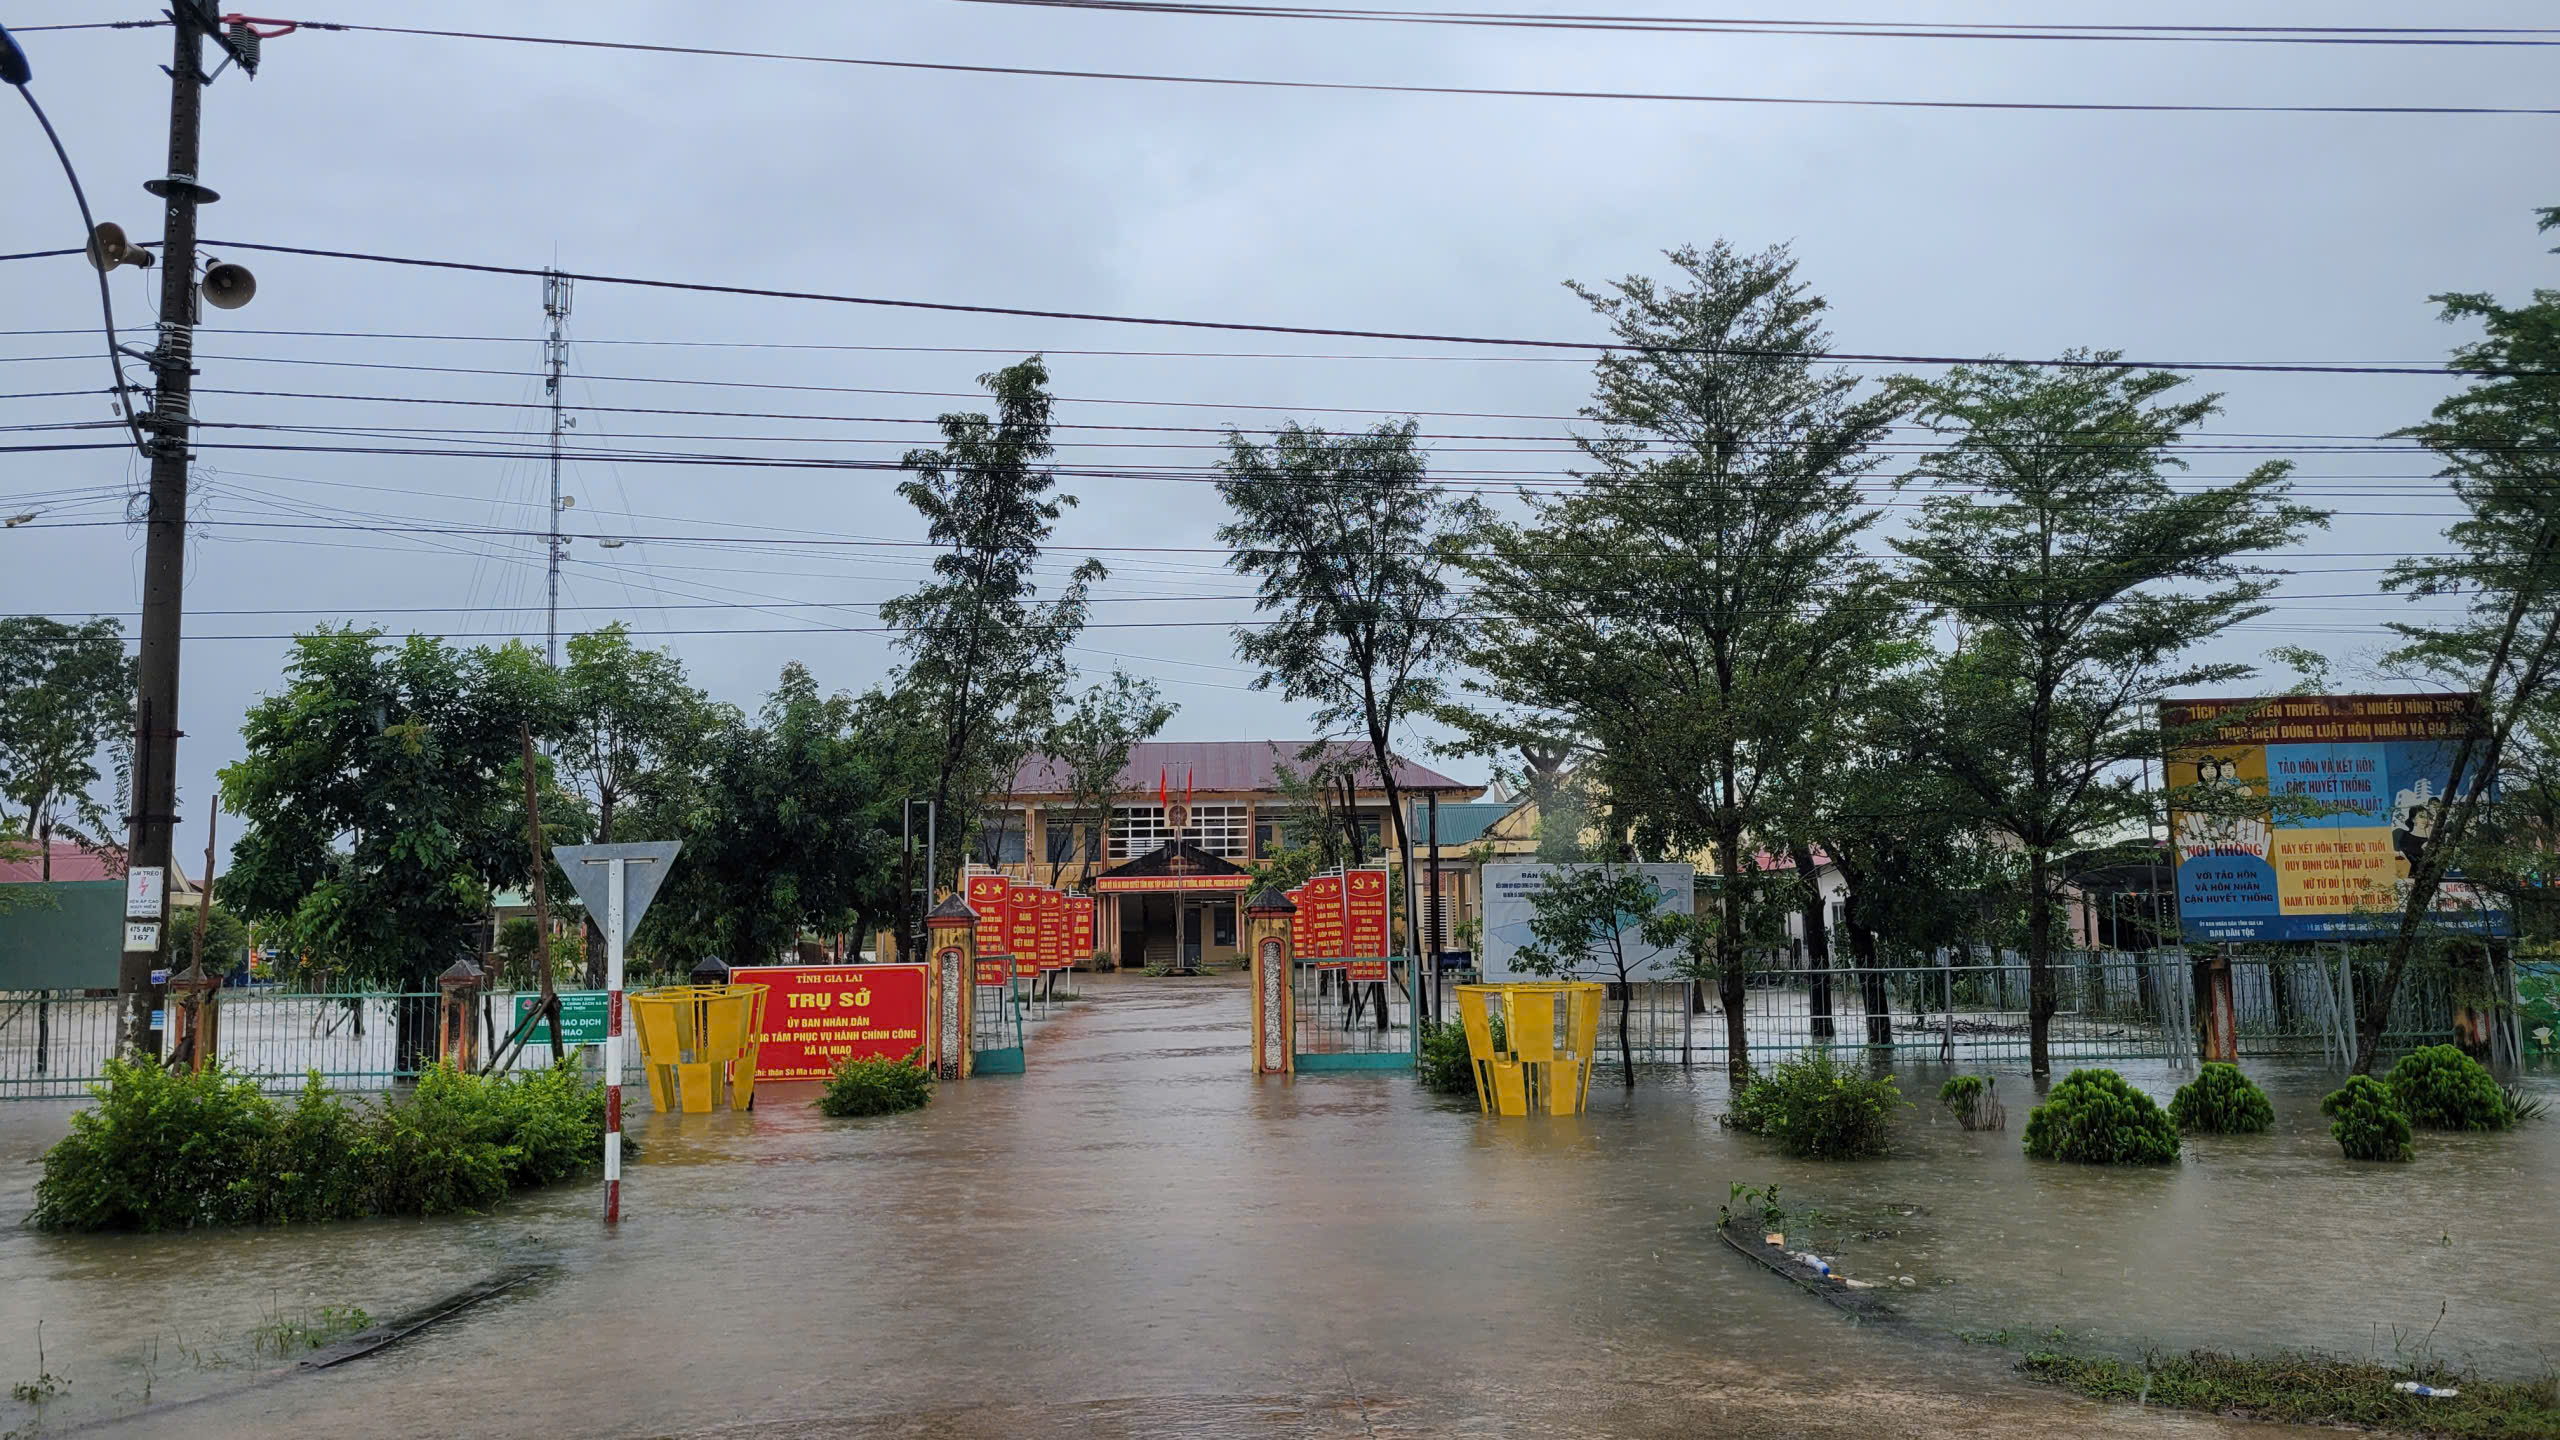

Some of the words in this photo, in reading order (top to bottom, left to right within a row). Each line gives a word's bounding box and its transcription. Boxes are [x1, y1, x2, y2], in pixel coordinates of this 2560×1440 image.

[2348, 721, 2371, 737] HÔN
[2374, 720, 2407, 736] NHÂN
[2298, 758, 2319, 774] HÔN
[2215, 841, 2263, 857] KHÔNG
[2315, 842, 2332, 853] HÔN
[2284, 896, 2302, 906] NAM
[796, 973, 821, 984] TỈNH
[824, 974, 843, 983] GIA
[845, 974, 864, 983] LAI
[787, 992, 832, 1011] TRỤ
[839, 987, 872, 1007] SỞ
[580, 1018, 601, 1028] DỊCH
[787, 1016, 799, 1028] ỦY
[801, 1018, 821, 1027] BAN
[823, 1016, 849, 1027] NHÂN
[850, 1016, 870, 1027] DÂN
[772, 1032, 791, 1042] TÂM
[793, 1032, 818, 1043] PHỤC
[820, 1031, 833, 1043] VỤ
[834, 1030, 859, 1041] HÀNH
[861, 1029, 890, 1040] CHÍNH
[891, 1028, 917, 1039] CÔNG
[804, 1044, 817, 1055] XÃ
[818, 1045, 829, 1055] IA
[830, 1045, 852, 1055] HIAO
[796, 1068, 808, 1076] Ma
[809, 1068, 826, 1077] Long
